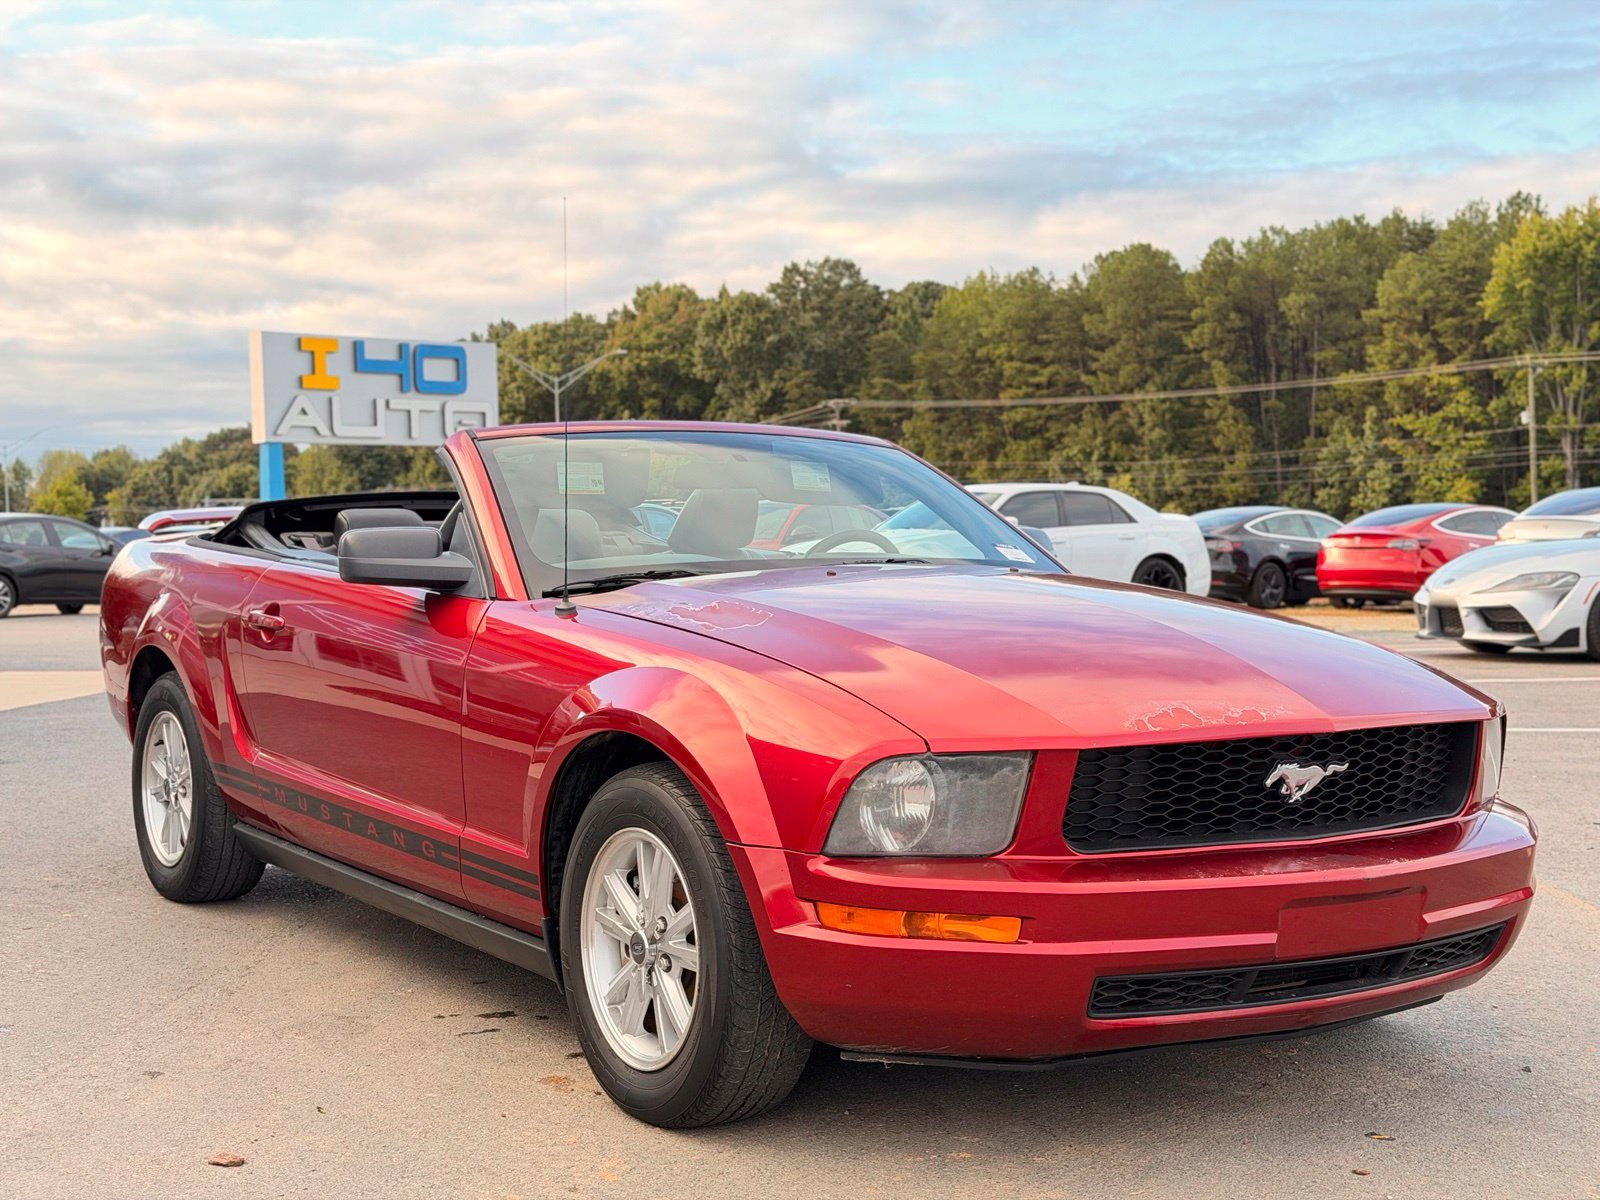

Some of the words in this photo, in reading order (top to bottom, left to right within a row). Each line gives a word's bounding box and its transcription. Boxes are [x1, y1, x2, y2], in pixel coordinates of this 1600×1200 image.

[299, 337, 340, 390] I
[354, 340, 467, 394] 40
[274, 395, 496, 439] AUTO
[273, 787, 436, 859] MUSTANG
